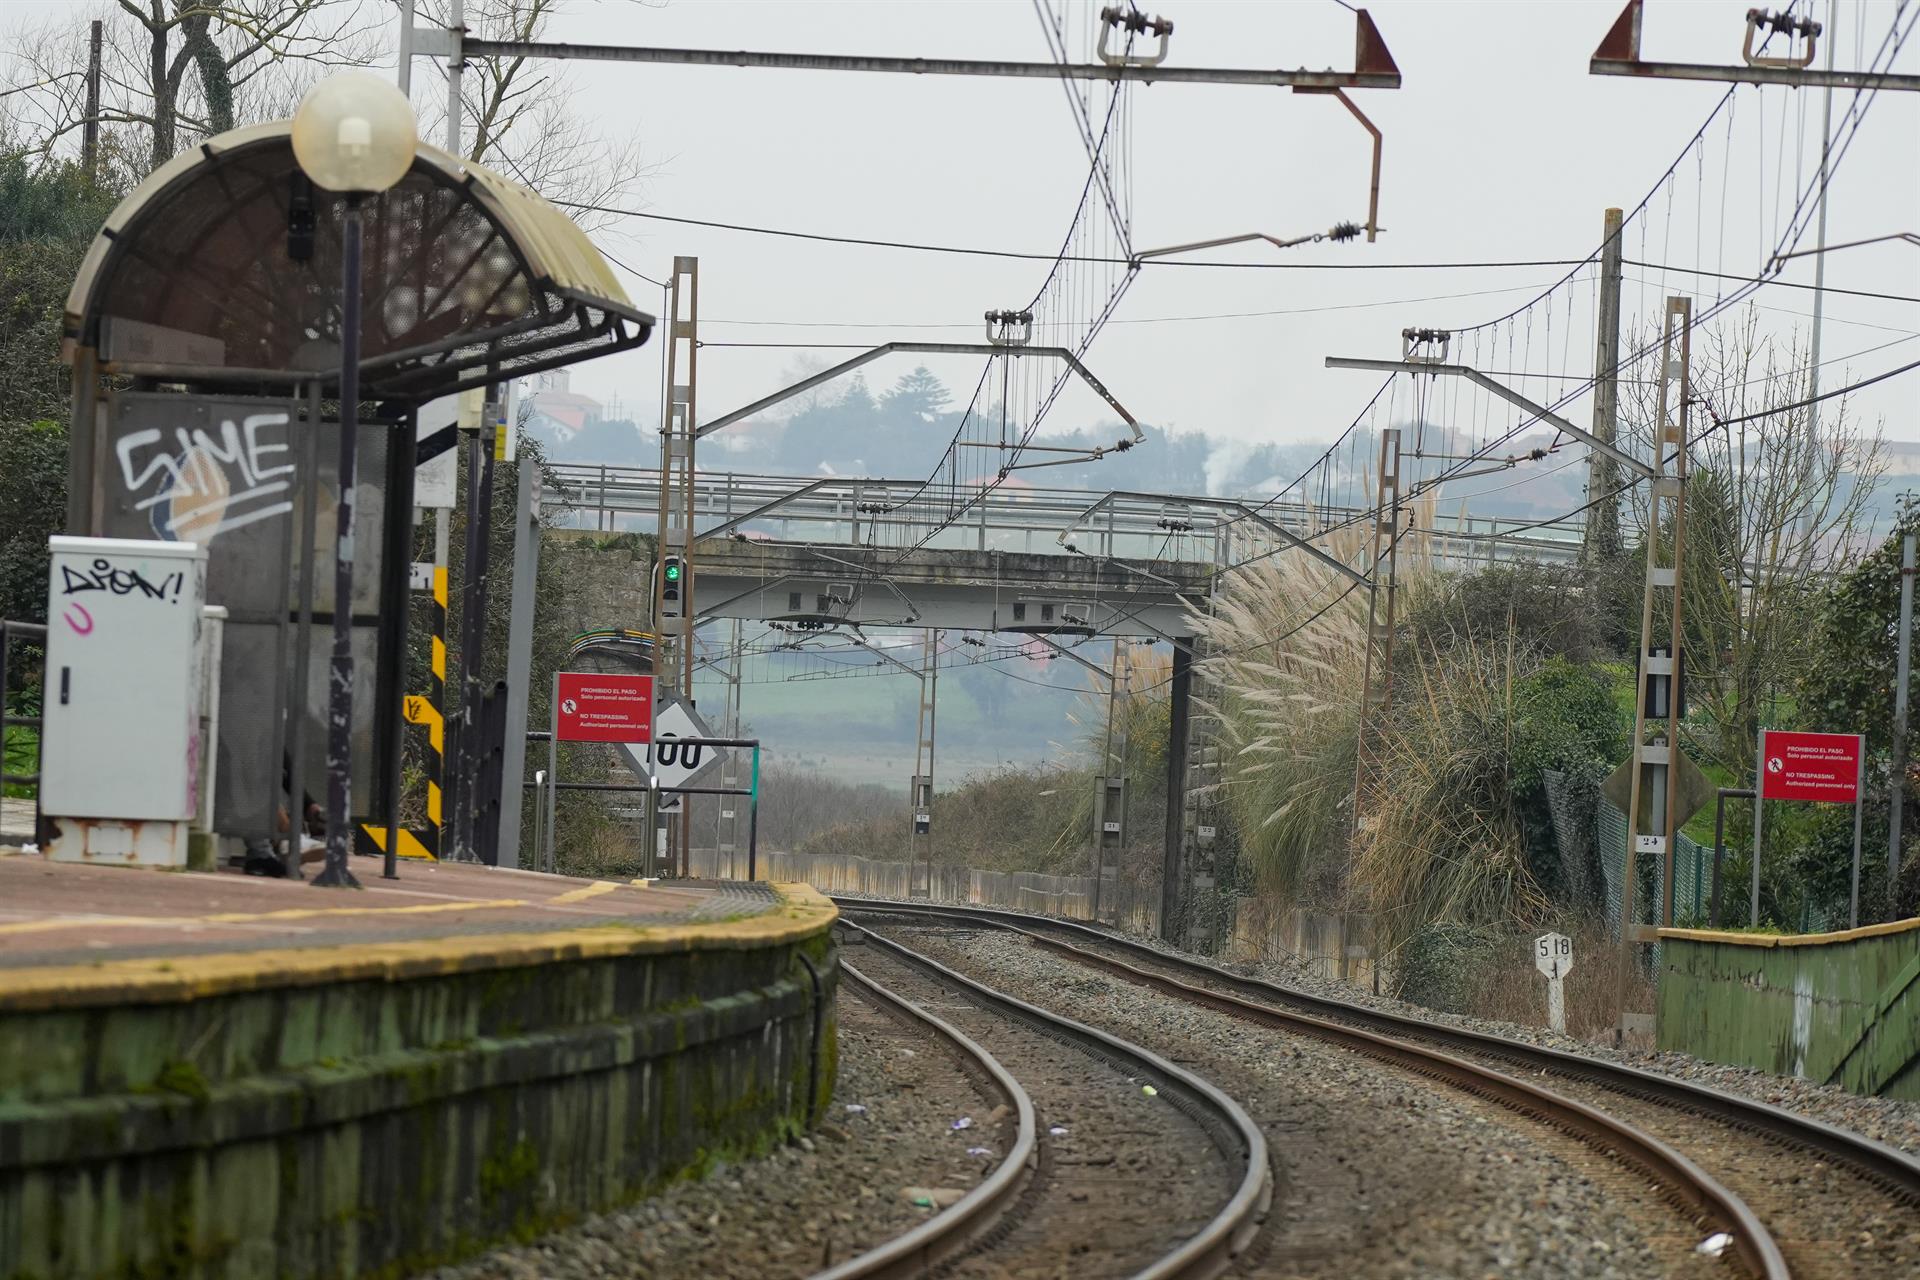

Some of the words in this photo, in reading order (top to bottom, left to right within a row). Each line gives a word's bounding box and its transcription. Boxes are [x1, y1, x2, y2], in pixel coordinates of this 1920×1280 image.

[1796, 772, 1835, 780] TRESPASSING
[1643, 837, 1658, 846] 24
[1540, 939, 1569, 957] 518
